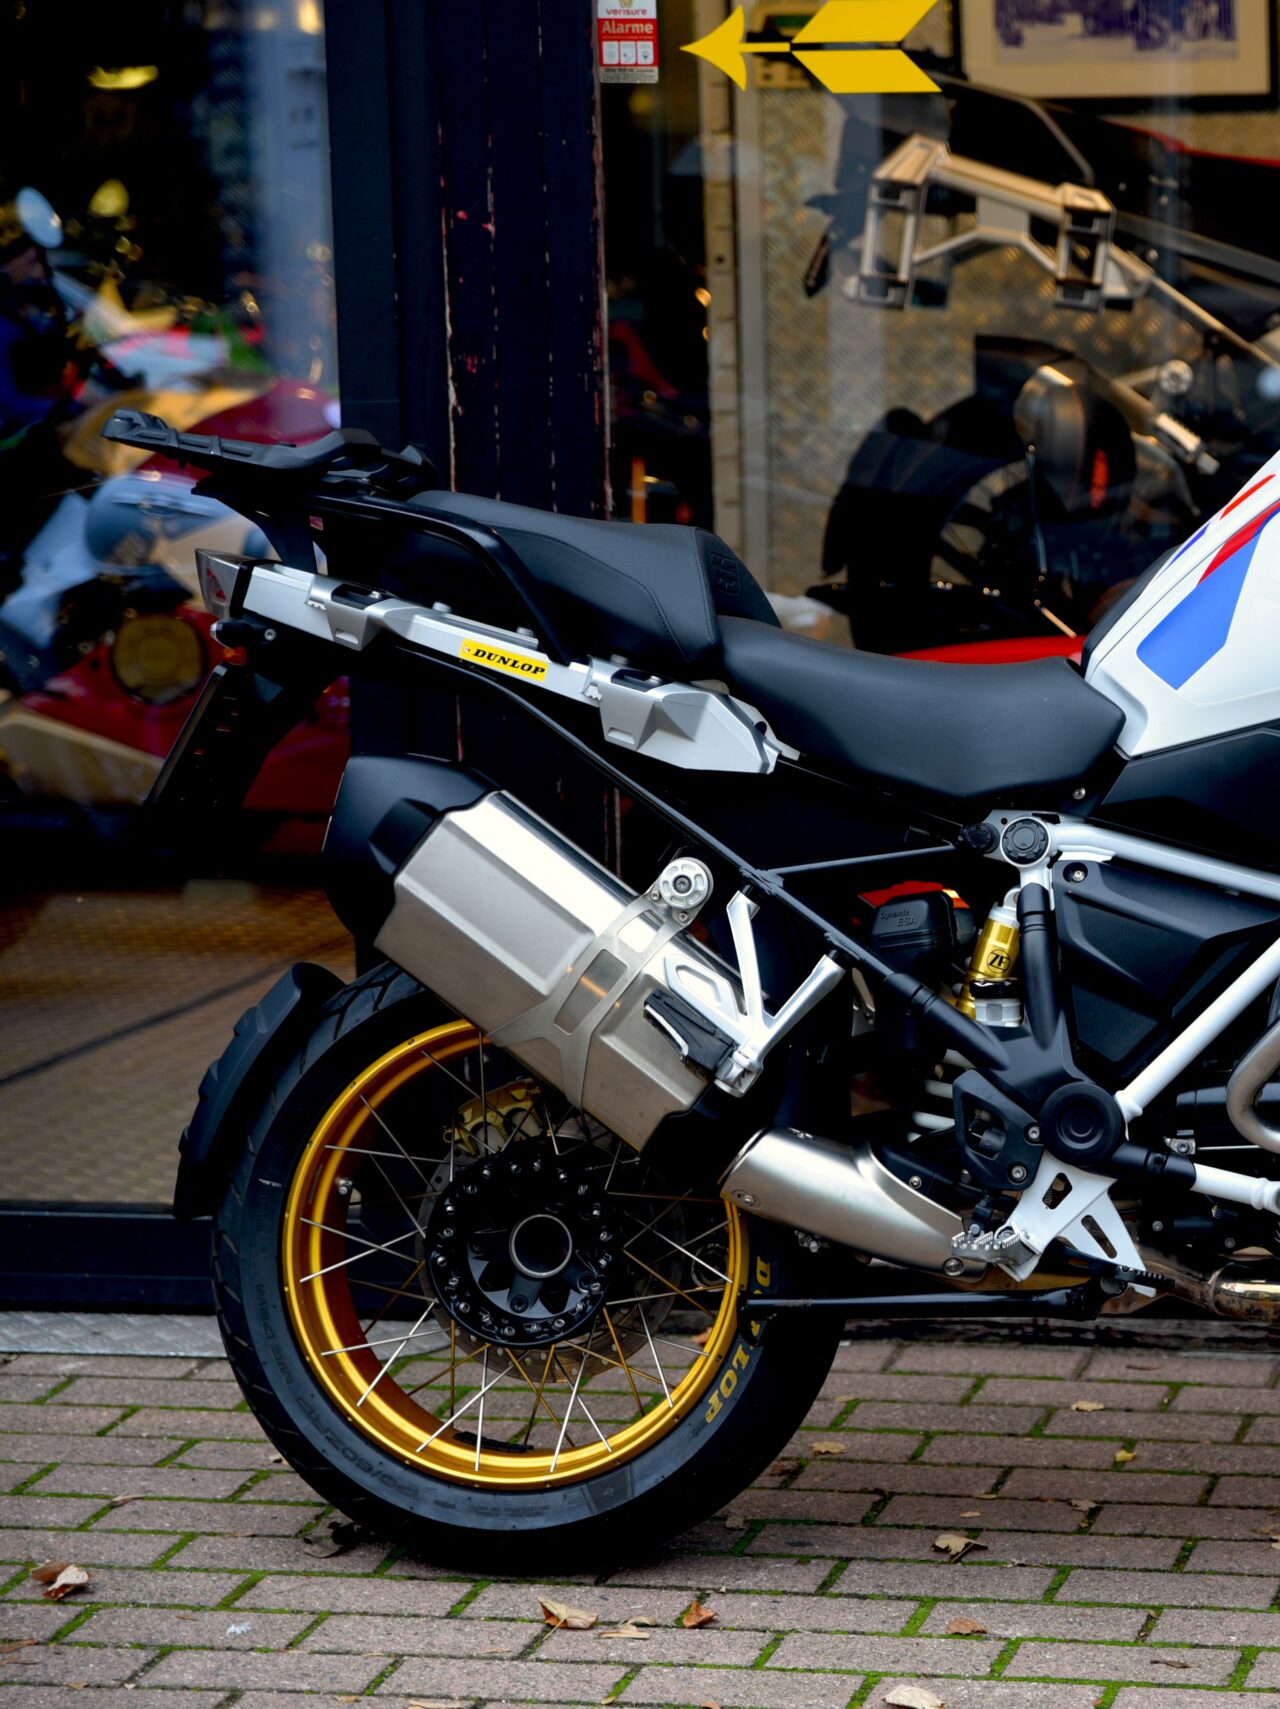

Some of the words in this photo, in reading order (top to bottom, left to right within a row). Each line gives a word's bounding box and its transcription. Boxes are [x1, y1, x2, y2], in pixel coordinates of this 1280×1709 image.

[606, 8, 648, 16] verisure
[602, 20, 654, 34] Alarme
[473, 648, 546, 675] DUNLOP
[879, 909, 910, 920] Dynamic
[896, 917, 919, 927] ESA
[988, 953, 1009, 968] ZF
[704, 1255, 771, 1424] DLOP
